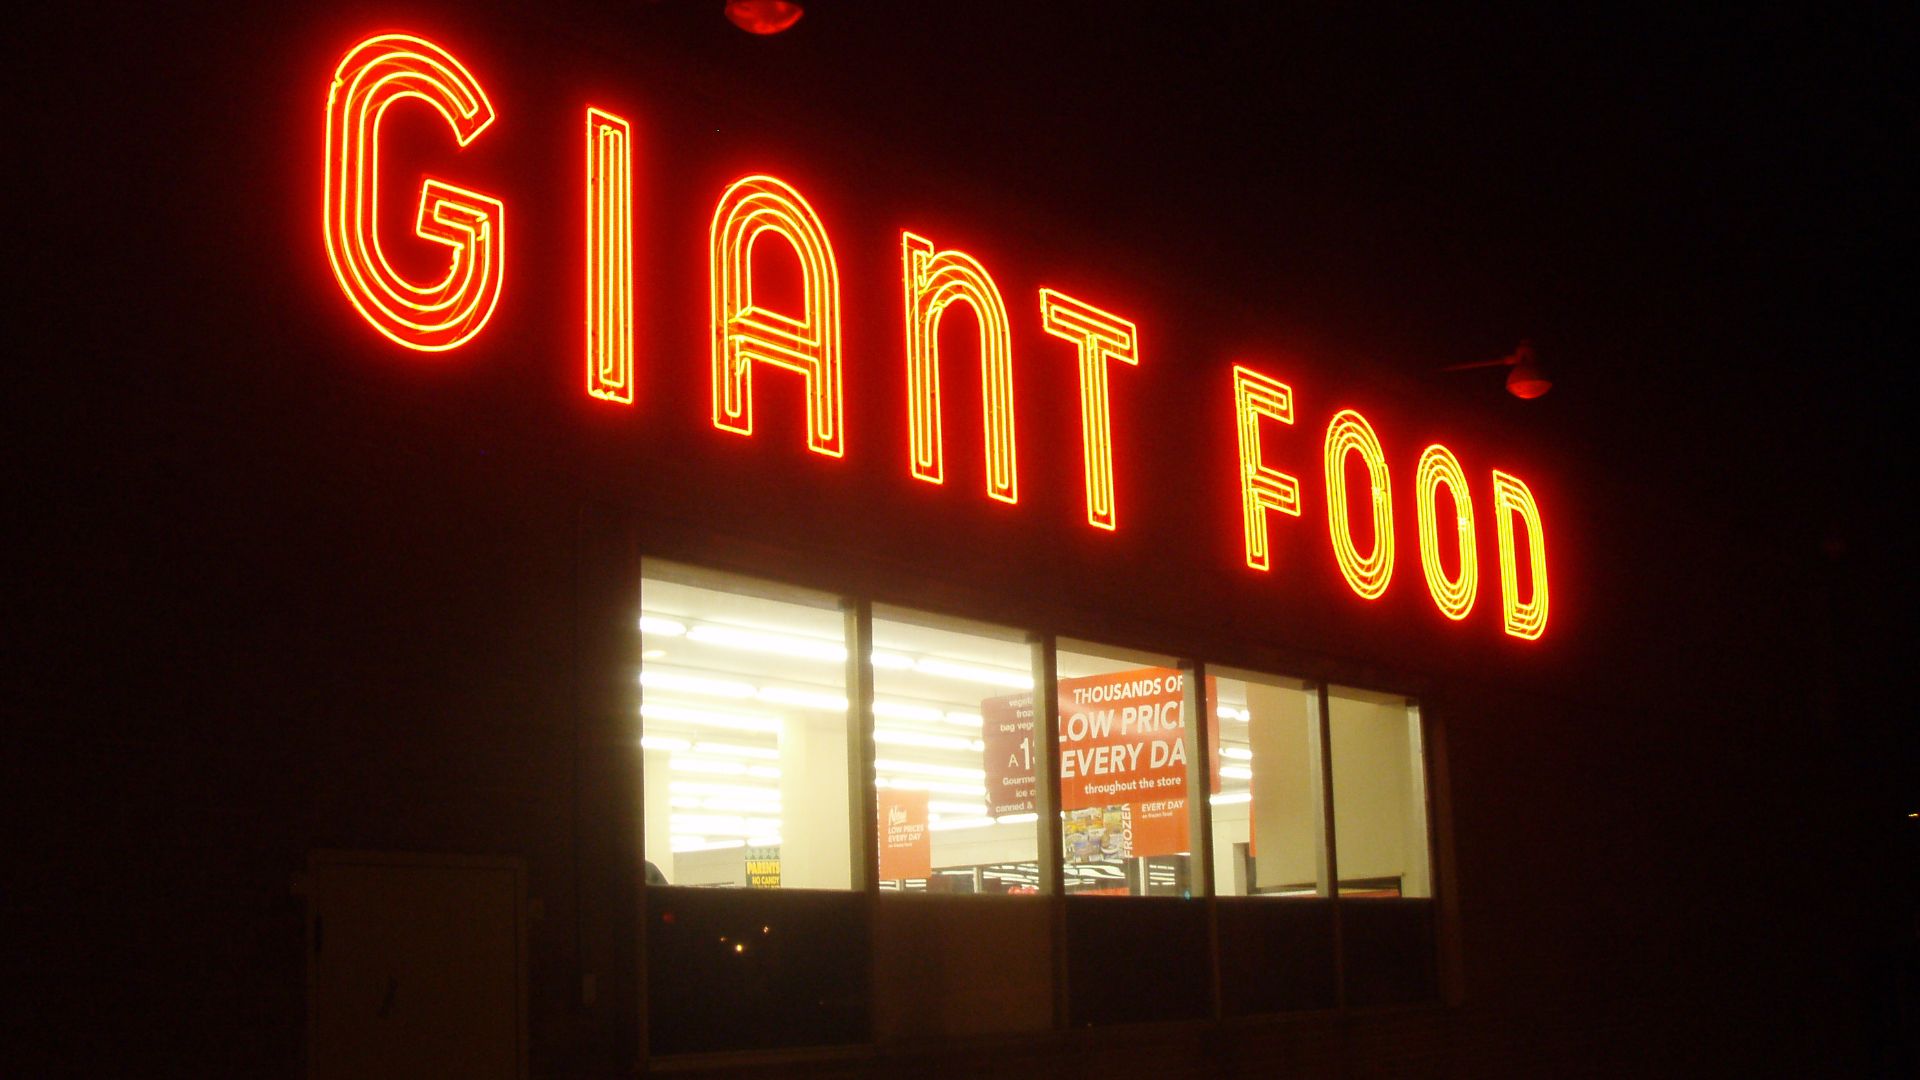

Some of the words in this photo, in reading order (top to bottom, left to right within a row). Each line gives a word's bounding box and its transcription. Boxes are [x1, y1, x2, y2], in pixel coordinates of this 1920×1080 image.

[1232, 363, 1551, 641] FOOD
[1073, 678, 1162, 705] THOUSANDS
[1165, 675, 1183, 693] OF
[1000, 723, 1015, 733] bag
[1058, 709, 1115, 743] LOW
[1020, 737, 1035, 770] 1
[1061, 742, 1144, 779] EVERY
[1150, 737, 1187, 769] DA
[1085, 780, 1137, 796] throughout
[1138, 777, 1155, 789] the
[1157, 776, 1182, 788] store
[1141, 801, 1167, 813] EVERY
[1167, 799, 1184, 810] DAY
[888, 825, 903, 835] LOW
[904, 823, 925, 833] PRICES
[888, 834, 908, 843] EVERY
[908, 833, 921, 841] DAY
